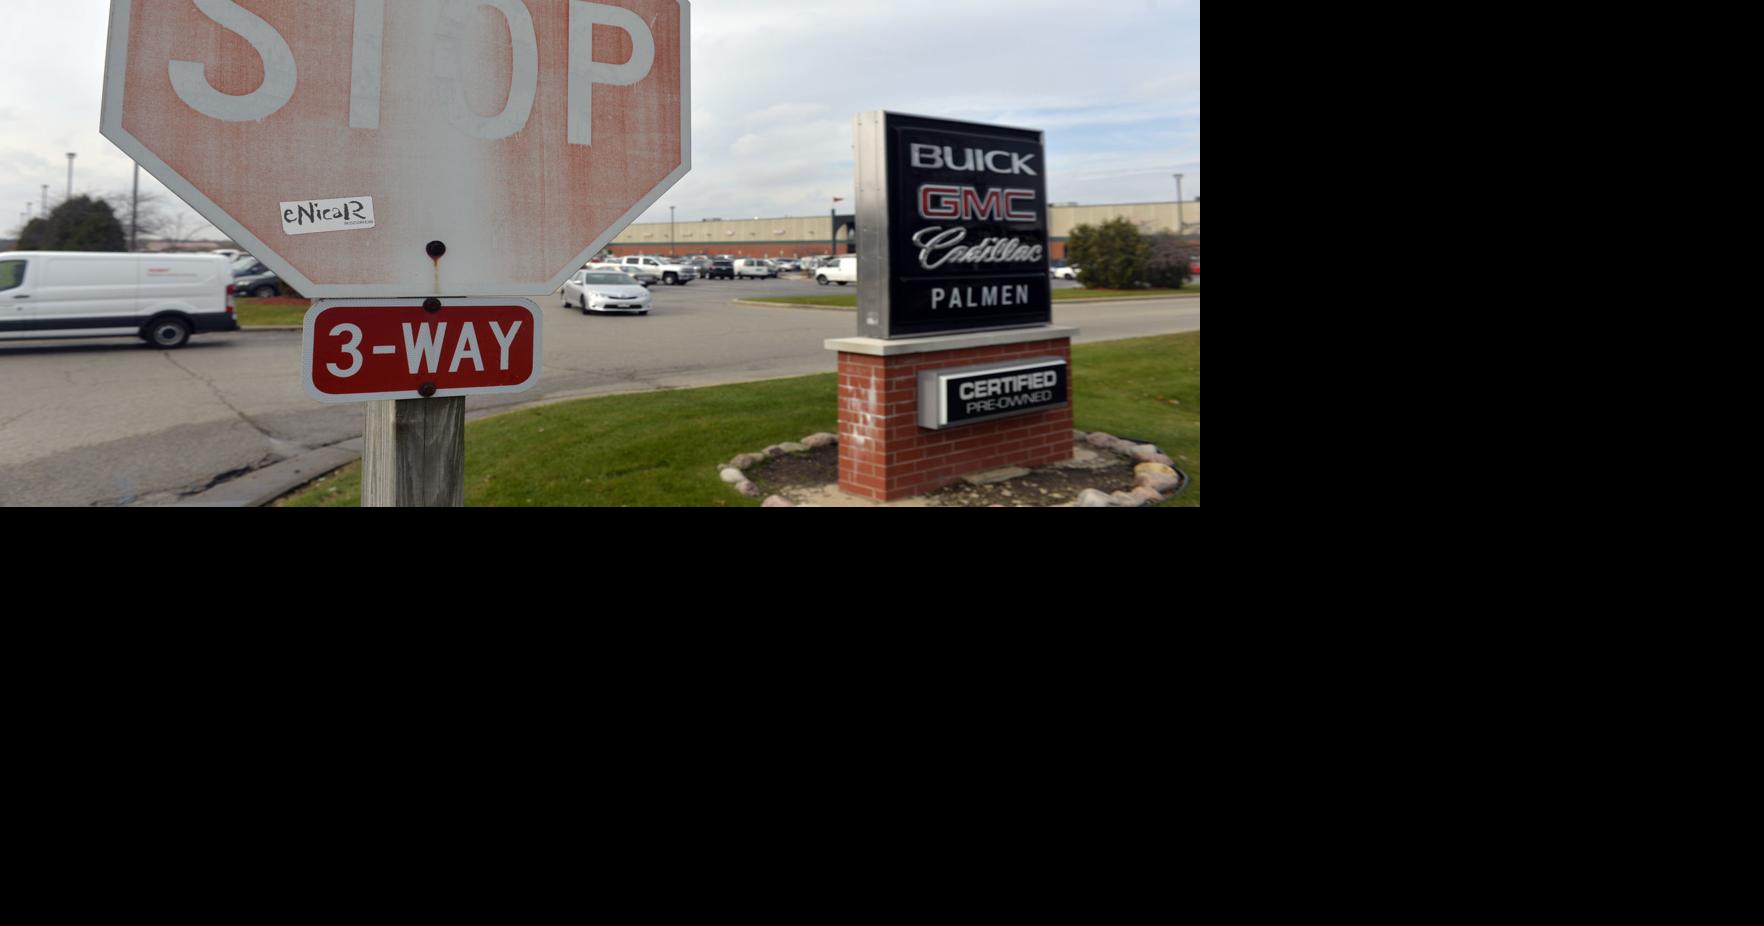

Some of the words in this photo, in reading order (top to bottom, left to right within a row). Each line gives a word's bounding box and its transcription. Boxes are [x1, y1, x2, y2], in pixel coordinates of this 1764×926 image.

[910, 143, 1038, 176] BUICK
[918, 184, 1037, 222] GMC
[912, 226, 1043, 270] Cadillac
[931, 284, 1029, 310] PALMEN
[326, 320, 523, 378] 3-WAY
[959, 370, 1057, 400] CERTIFIED
[966, 390, 1052, 414] PRE-OWNED
